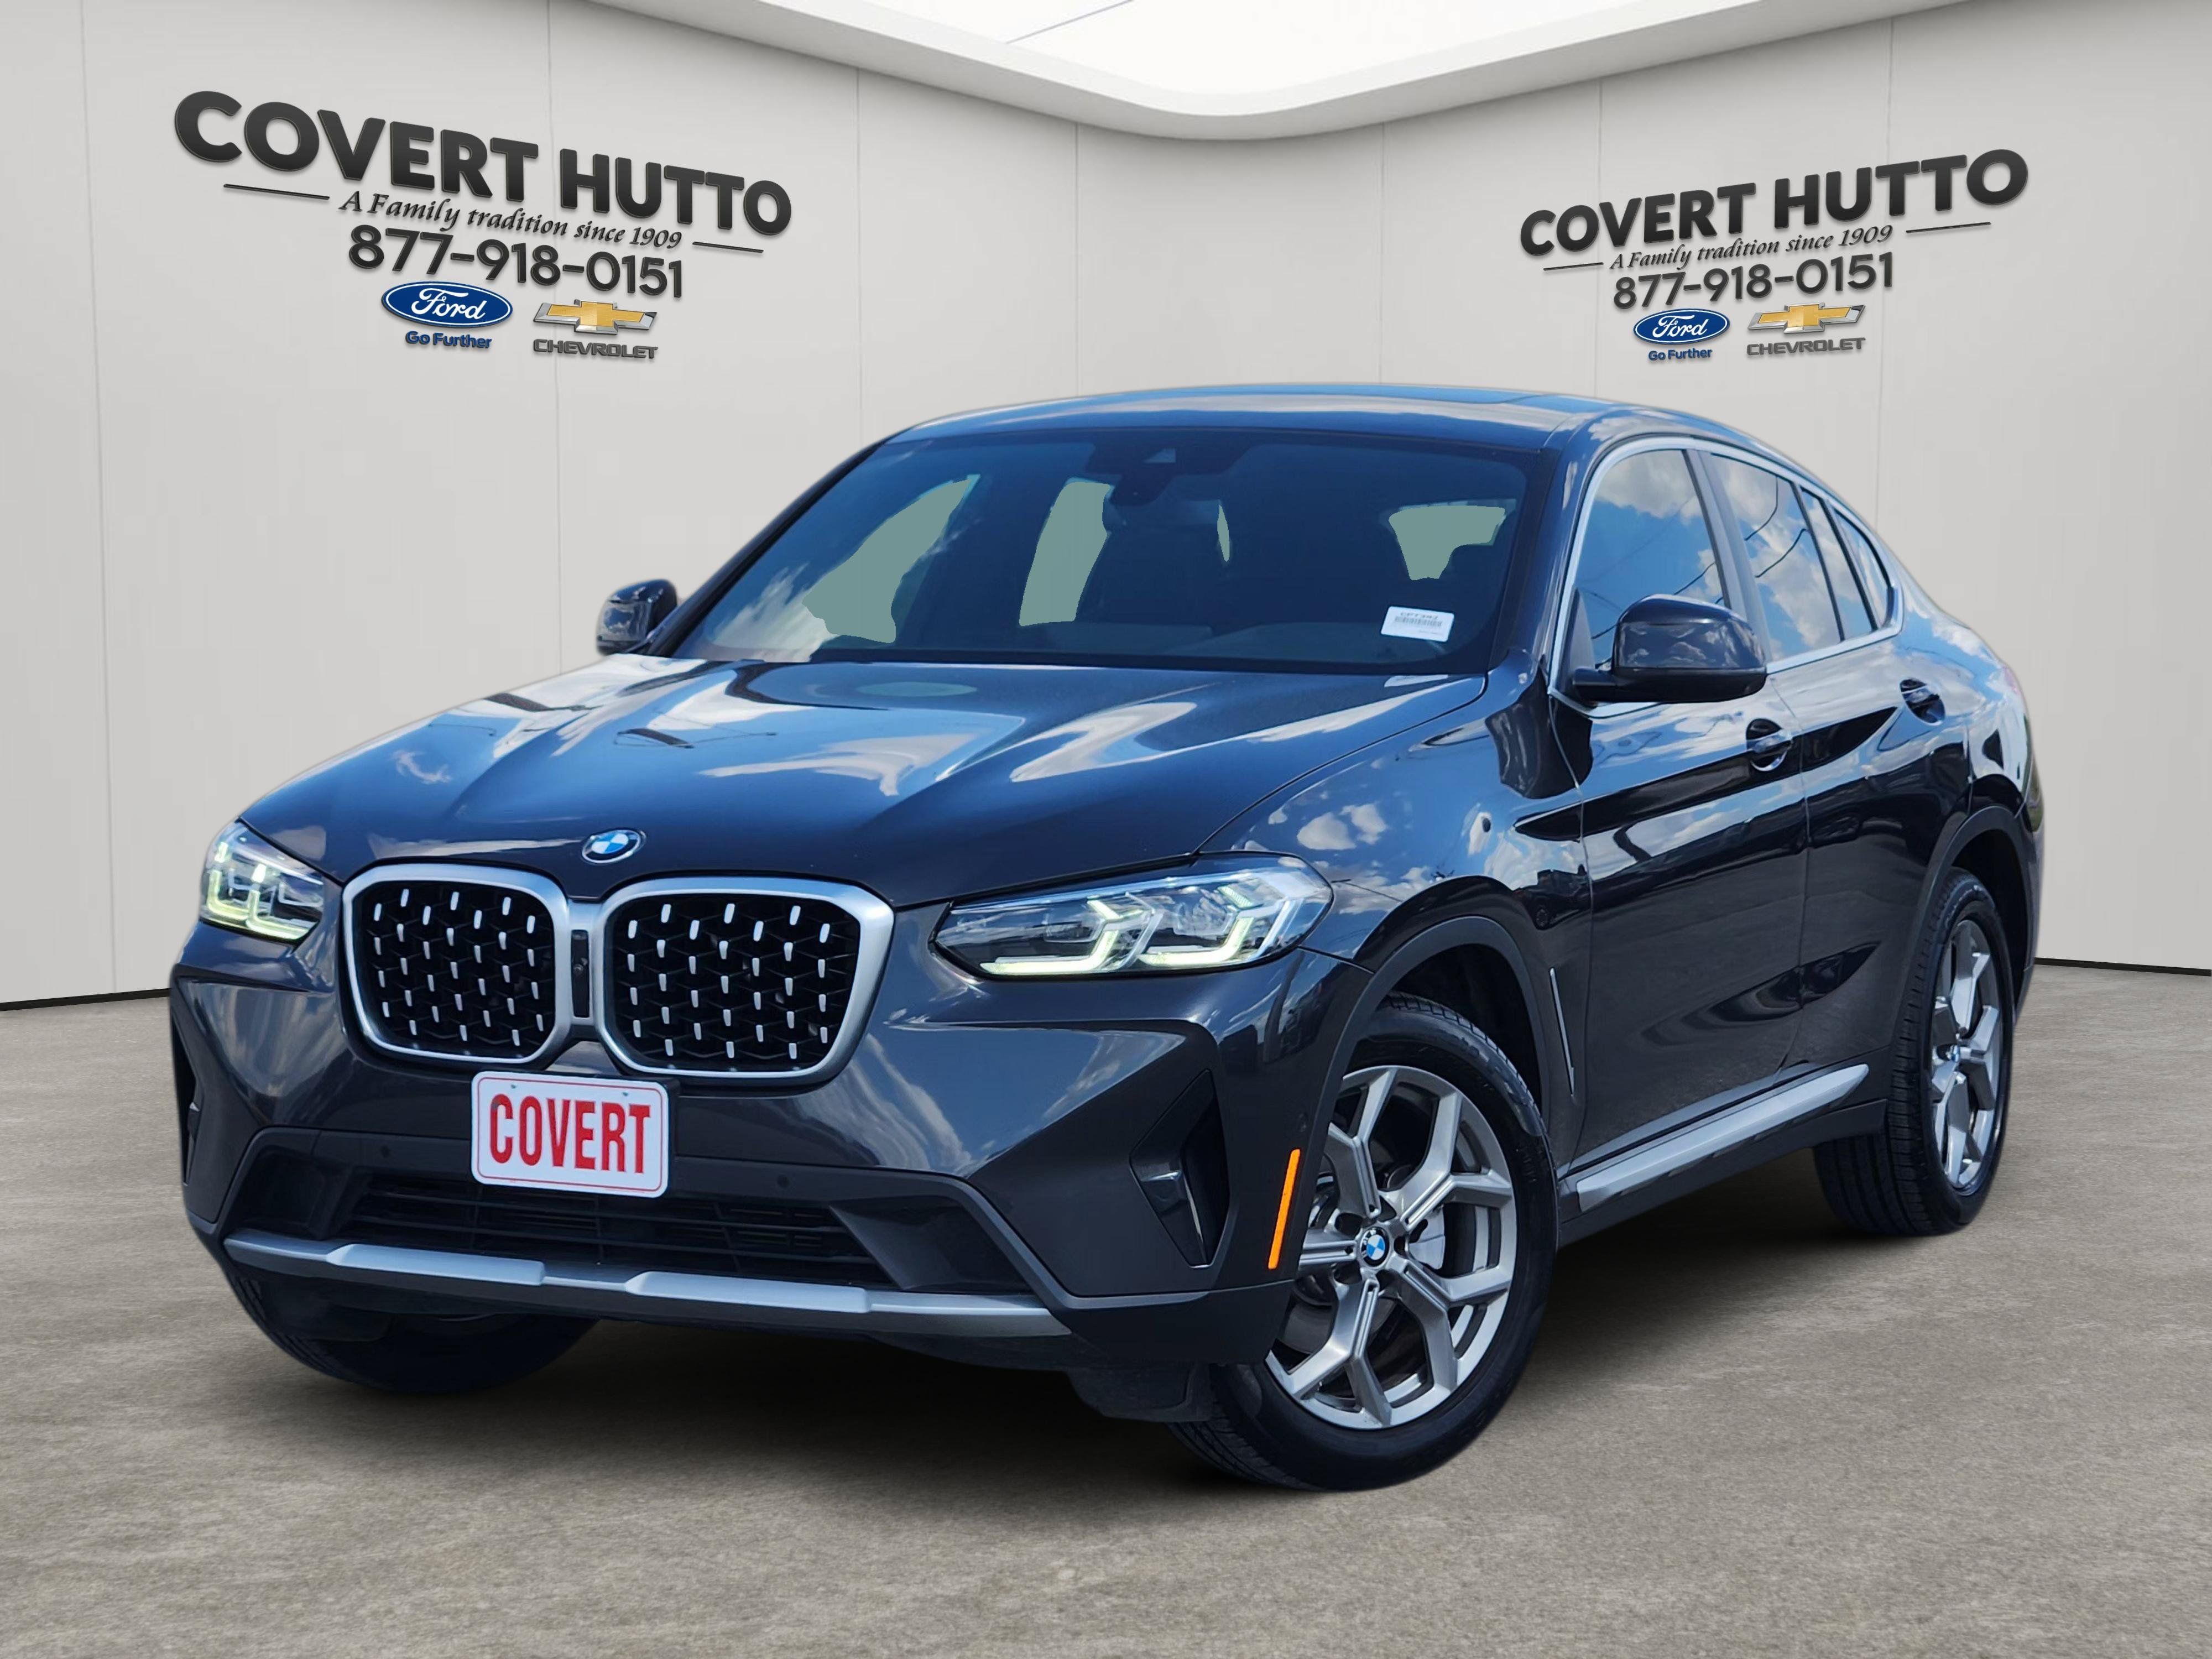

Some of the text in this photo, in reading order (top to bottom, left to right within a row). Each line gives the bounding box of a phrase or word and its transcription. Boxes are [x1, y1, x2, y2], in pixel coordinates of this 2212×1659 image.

[174, 91, 791, 236] COVERT HUTTO
[338, 191, 682, 249] A Family tradition since 1909
[1520, 149, 2028, 257] COVERT HUTTO
[348, 225, 682, 299] 877-918-0151
[1609, 225, 1893, 270] A Family tradition since 1909
[1614, 252, 1892, 310] 877-918-0151
[411, 288, 487, 320] Ford
[1652, 315, 1709, 337] Ford
[405, 331, 492, 349] Go Further
[533, 338, 658, 359] CHEVROLET
[1648, 347, 1713, 361] Go Further
[1746, 337, 1866, 356] CHEVROLET
[489, 1093, 651, 1174] COVERT
